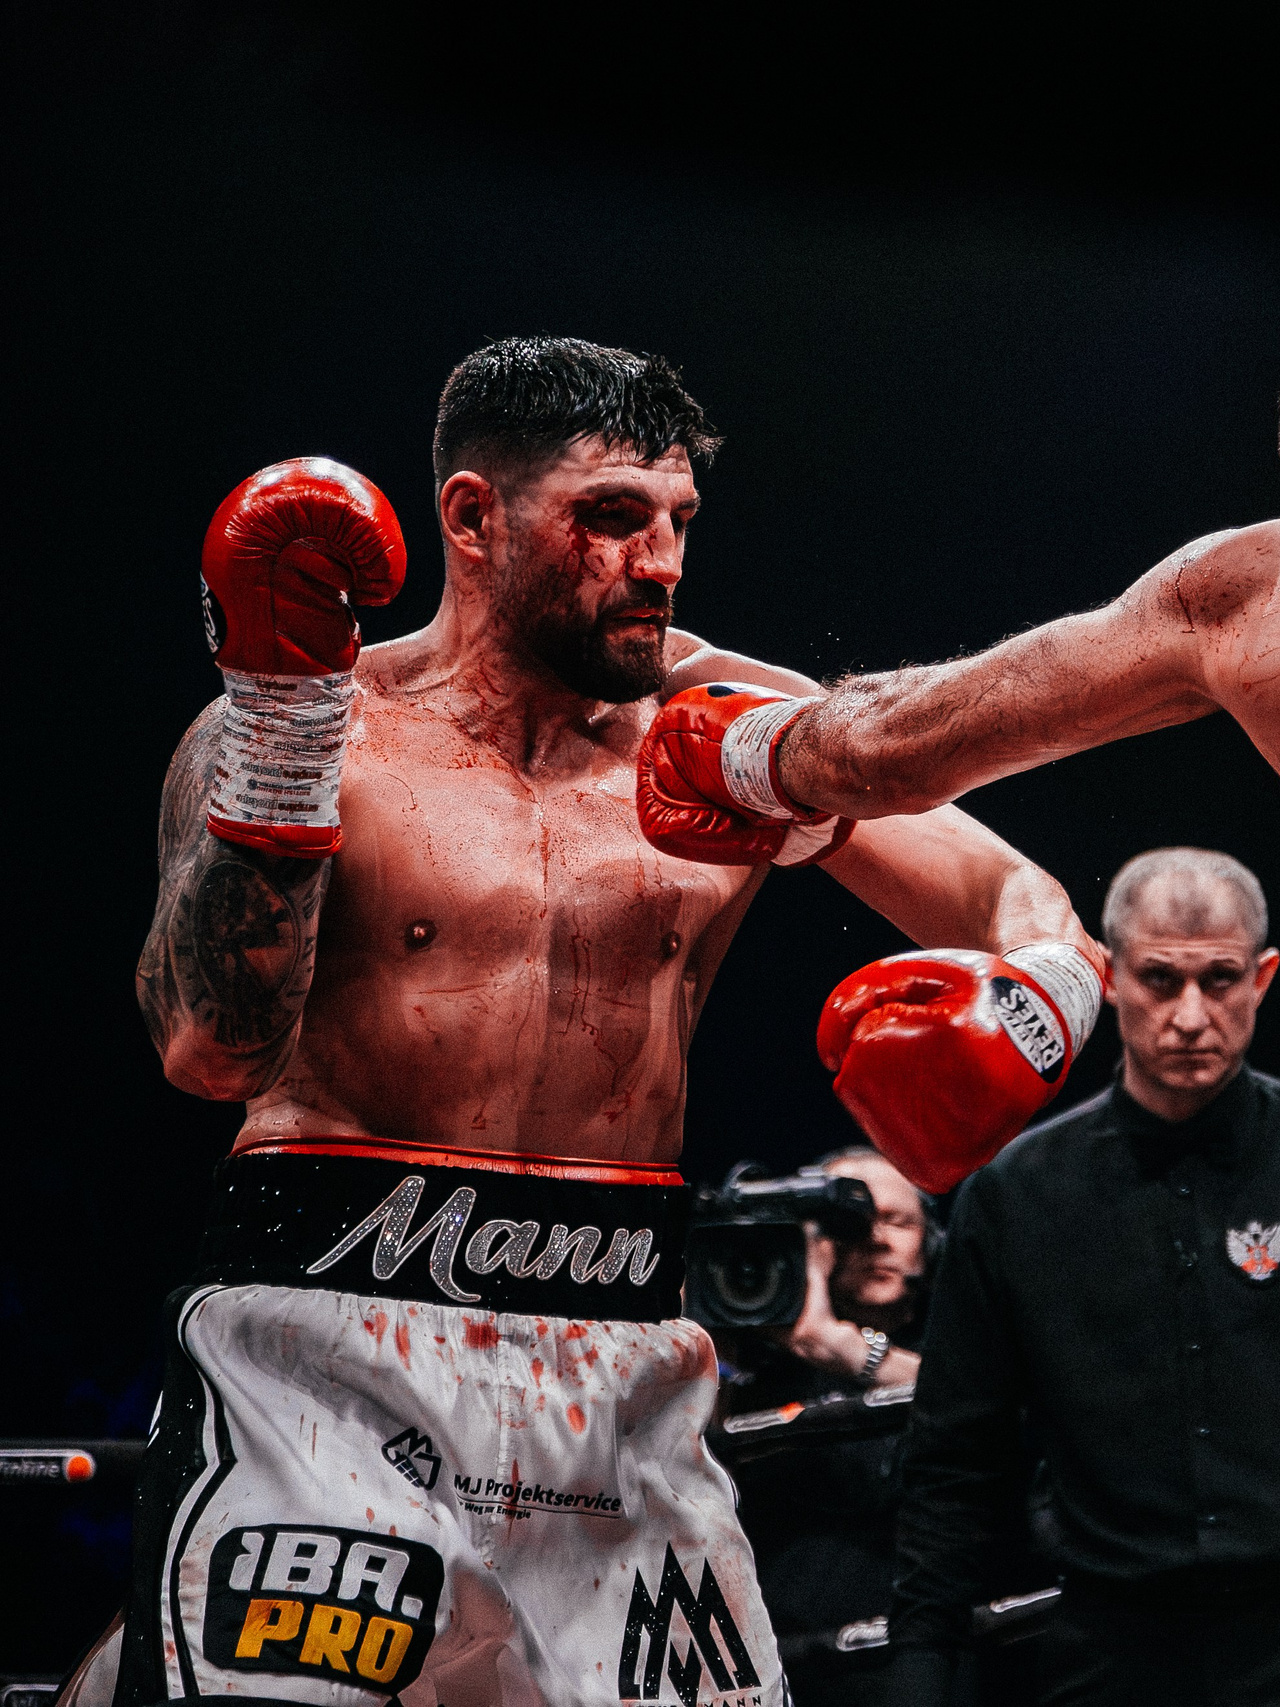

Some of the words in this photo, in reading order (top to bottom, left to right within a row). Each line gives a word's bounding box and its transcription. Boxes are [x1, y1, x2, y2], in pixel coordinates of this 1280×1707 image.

[1000, 988, 1065, 1069] REYES
[306, 1175, 660, 1302] Mann
[453, 1474, 482, 1496] MJ
[485, 1479, 622, 1512] Projektservice
[235, 1599, 414, 1684] PRO
